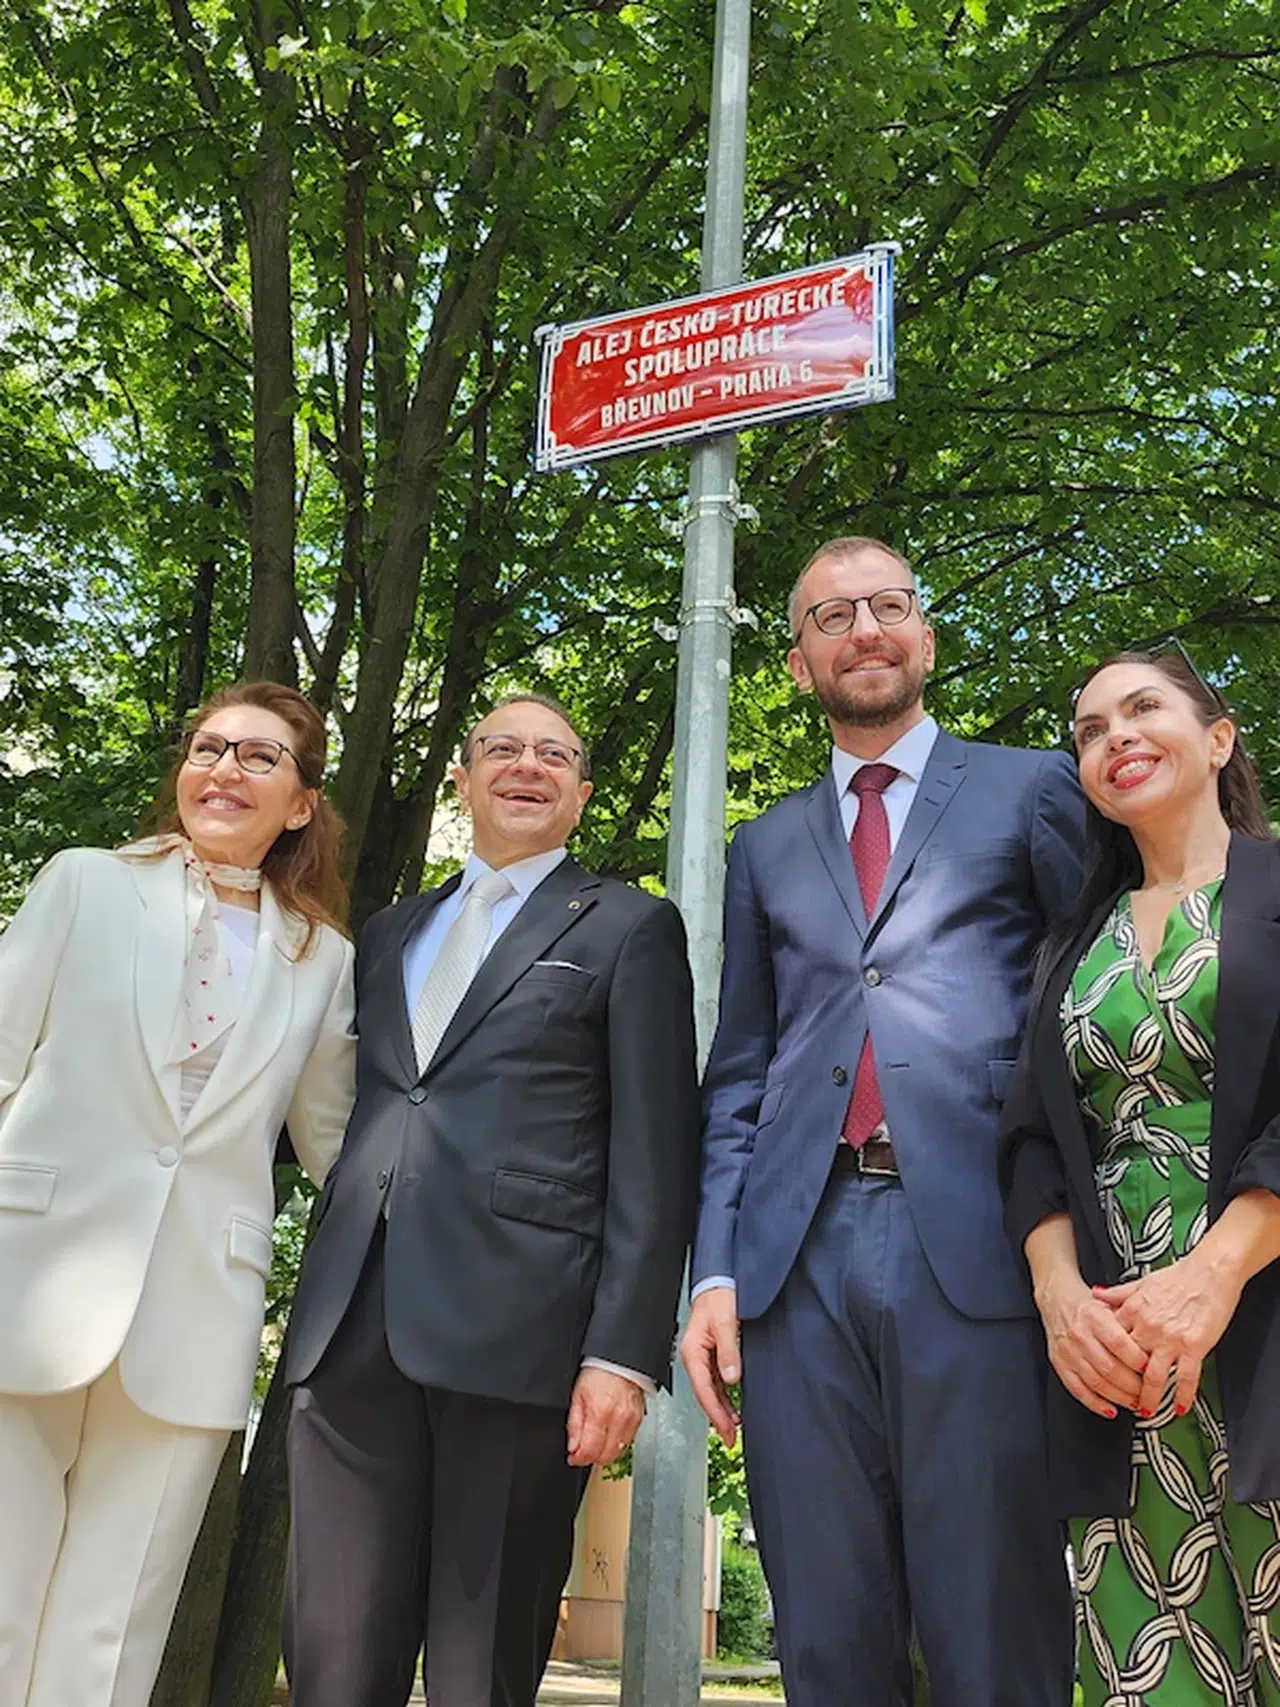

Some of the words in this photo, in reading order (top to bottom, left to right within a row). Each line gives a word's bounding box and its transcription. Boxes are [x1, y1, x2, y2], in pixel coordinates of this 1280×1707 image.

[576, 331, 632, 367] ALEJ
[640, 281, 846, 349] ČESKO-TURECKÉ
[624, 325, 788, 386] SPOLUPRÁCE
[601, 384, 693, 428] BŘEVNOV
[720, 365, 792, 401] PRAHA
[800, 360, 813, 383] 6
